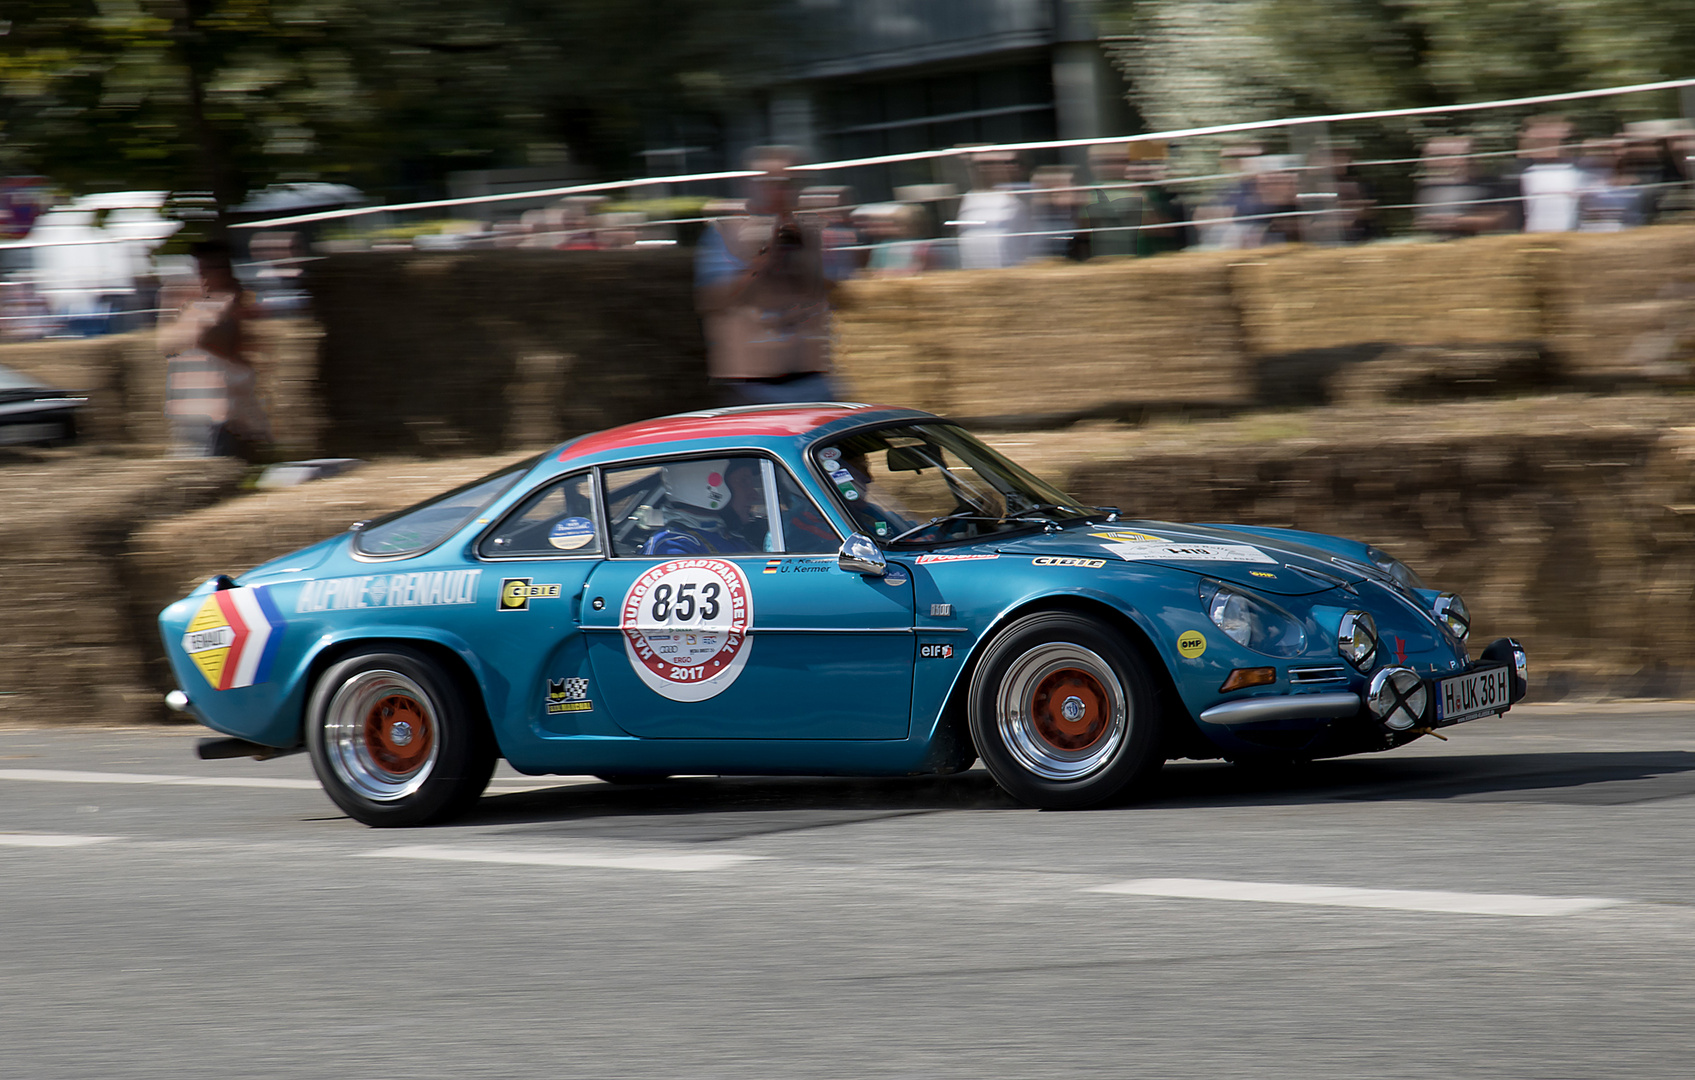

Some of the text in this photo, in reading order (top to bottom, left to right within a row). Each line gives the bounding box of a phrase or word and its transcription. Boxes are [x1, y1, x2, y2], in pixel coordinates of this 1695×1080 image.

[295, 569, 483, 613] ALPINE RENAULT
[652, 582, 720, 622] 853
[625, 569, 664, 660] HAMBURGER
[921, 644, 941, 657] elf
[1181, 639, 1202, 649] OMP
[670, 666, 705, 680] 2017
[673, 656, 692, 664] ERGO
[1445, 671, 1507, 715] H UK 38 H
